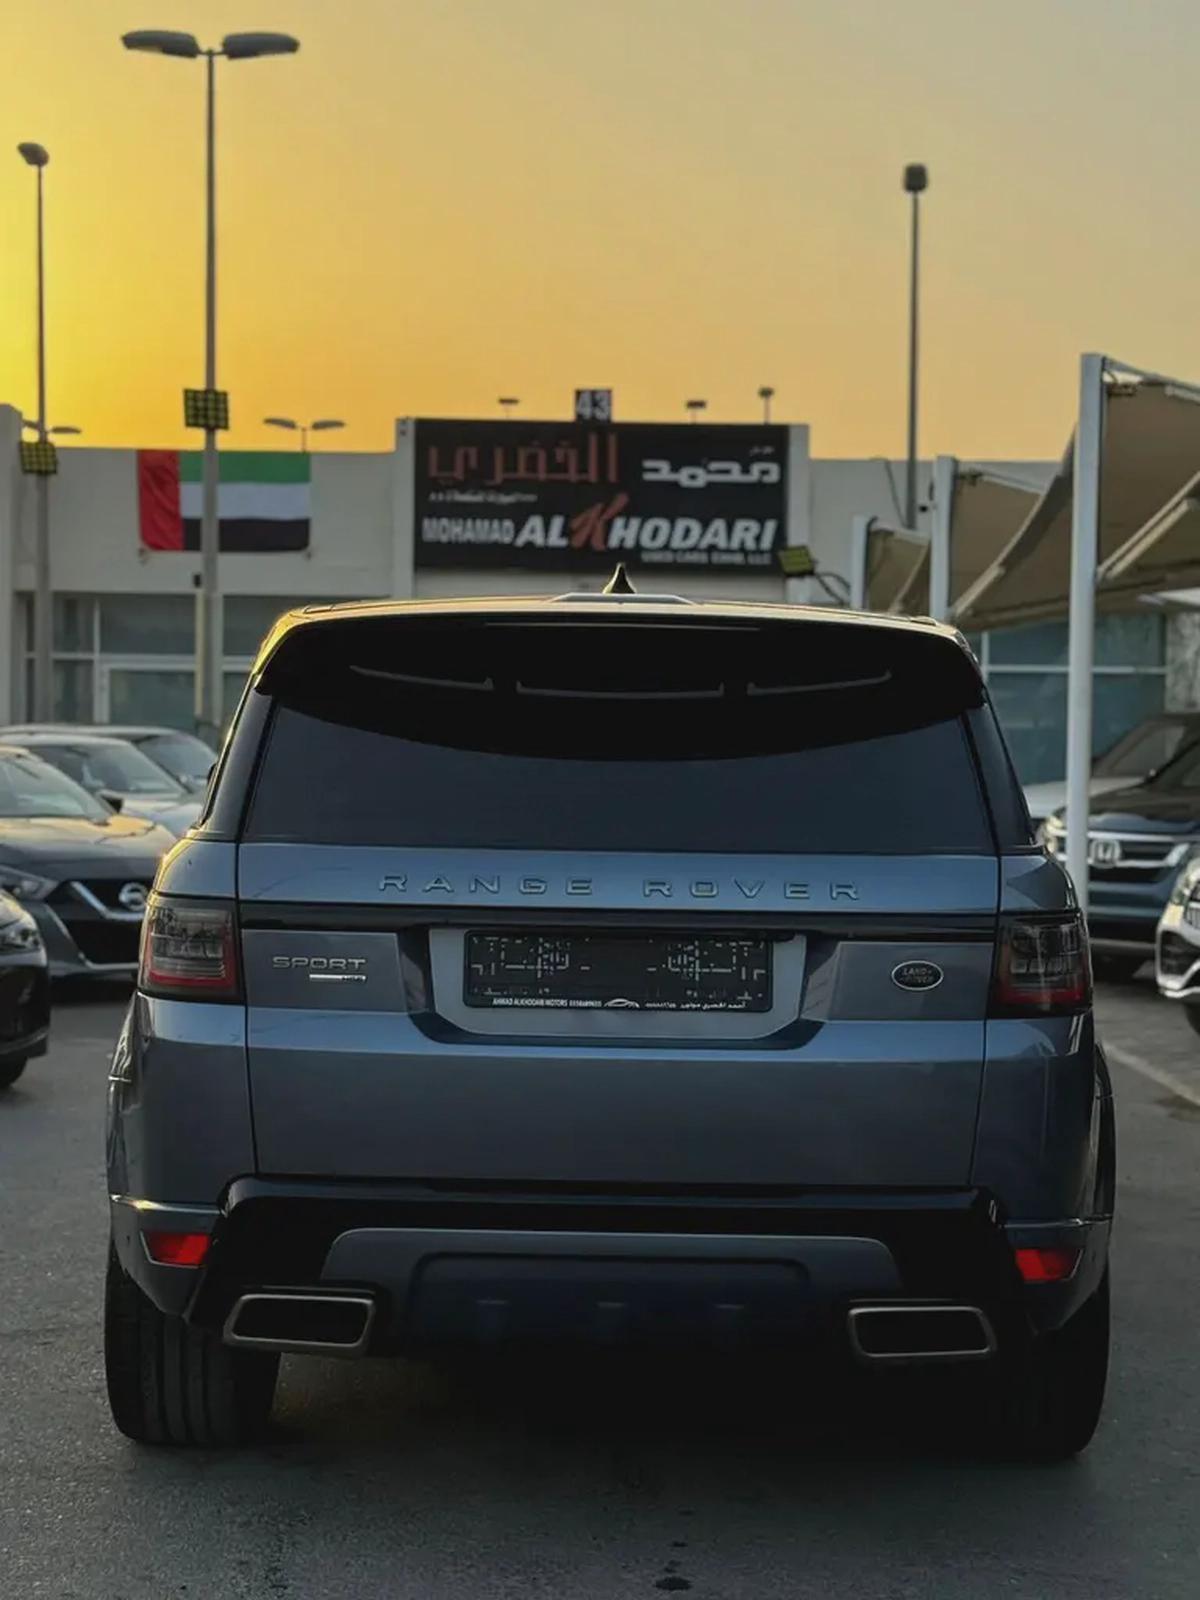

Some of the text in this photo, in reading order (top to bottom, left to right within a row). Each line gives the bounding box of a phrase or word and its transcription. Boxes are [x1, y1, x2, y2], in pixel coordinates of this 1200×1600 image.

[575, 391, 609, 419] 43
[642, 460, 780, 488] محمد
[421, 516, 514, 543] MOHAMAD
[378, 874, 860, 901] RANGE ROVER
[272, 956, 367, 971] SPORT
